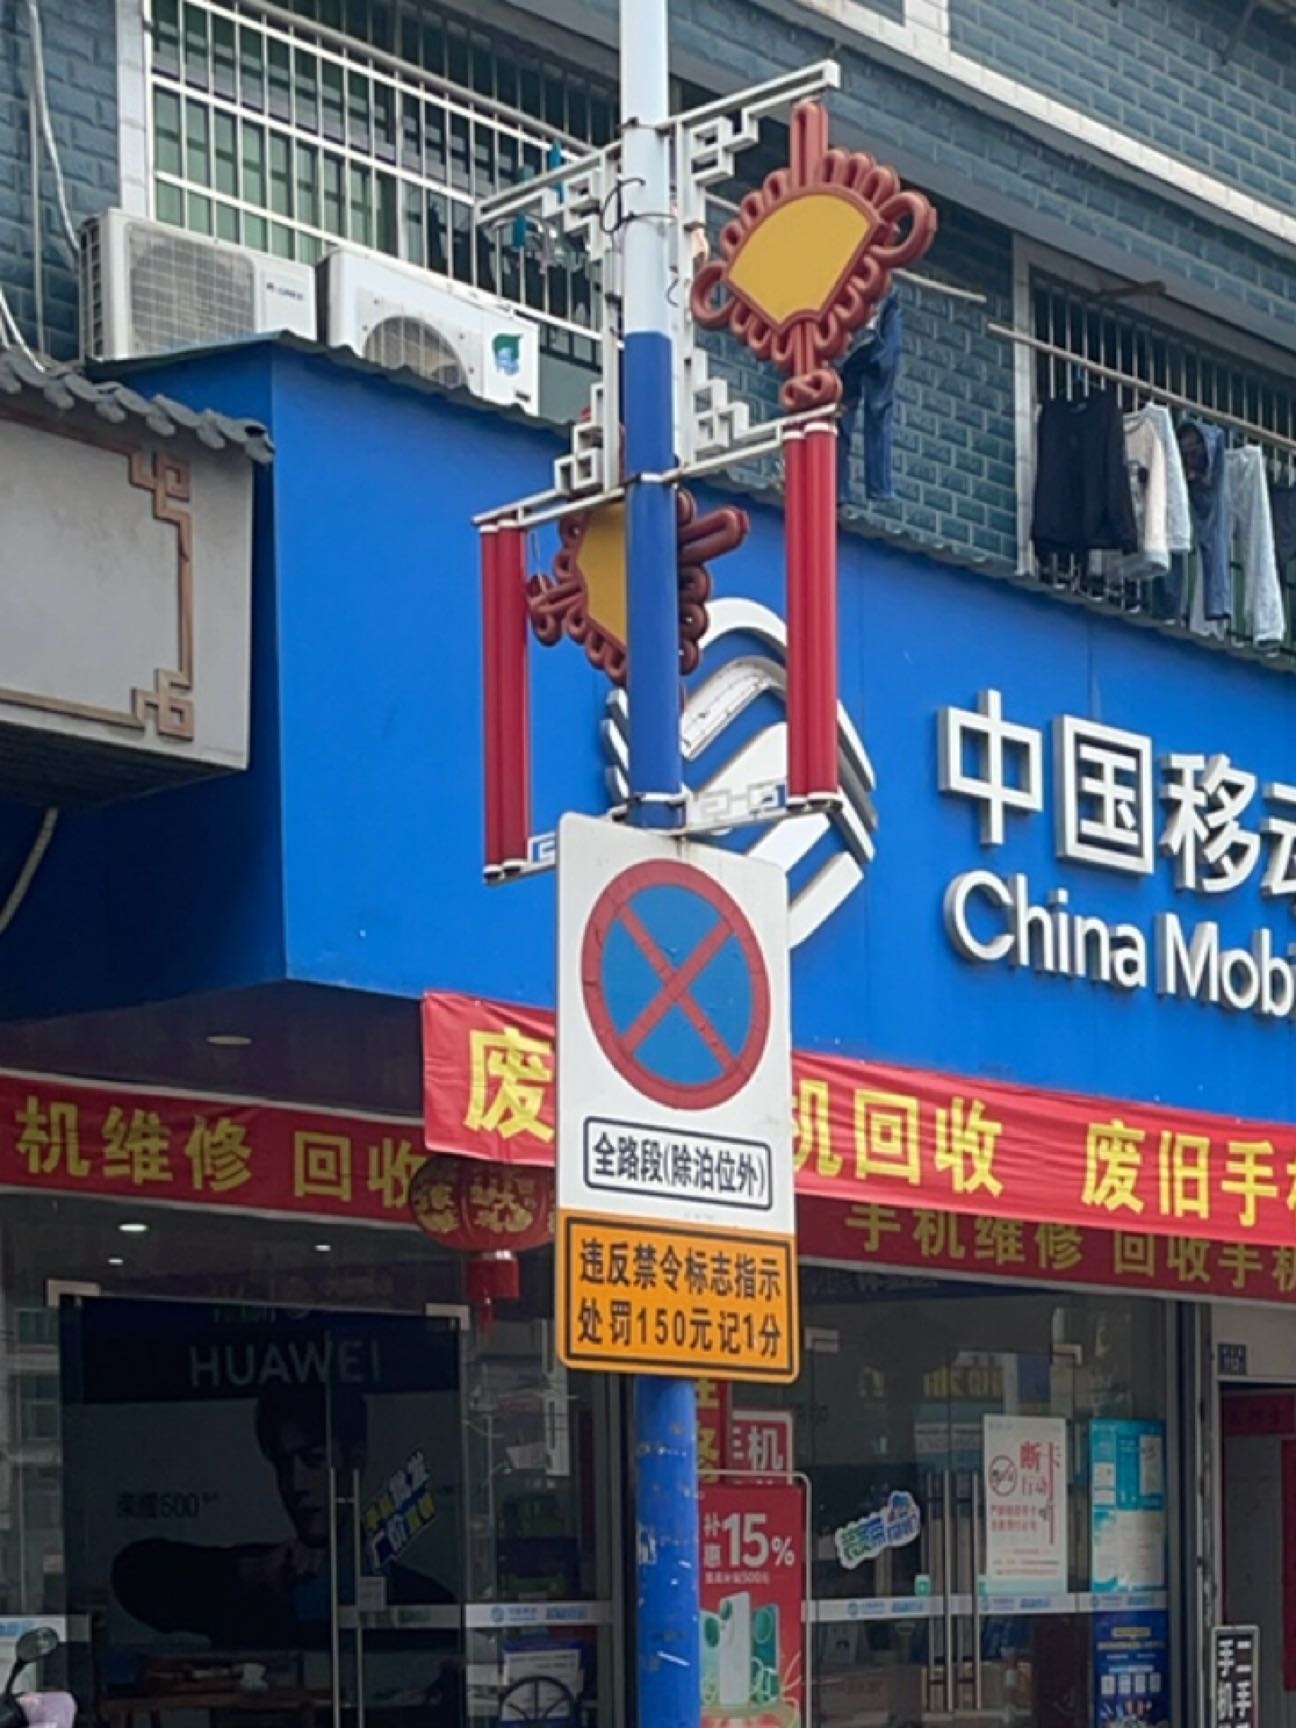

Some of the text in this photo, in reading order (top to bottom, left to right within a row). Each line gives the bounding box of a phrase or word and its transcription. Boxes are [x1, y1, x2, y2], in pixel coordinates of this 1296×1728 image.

[942, 870, 1147, 993] China
[594, 1132, 766, 1197] 全路段(除泊位外)
[580, 1238, 781, 1301] 违反禁令标志指示
[577, 1297, 781, 1357] 处罚150元记1分
[190, 1338, 382, 1389] HUAWEI
